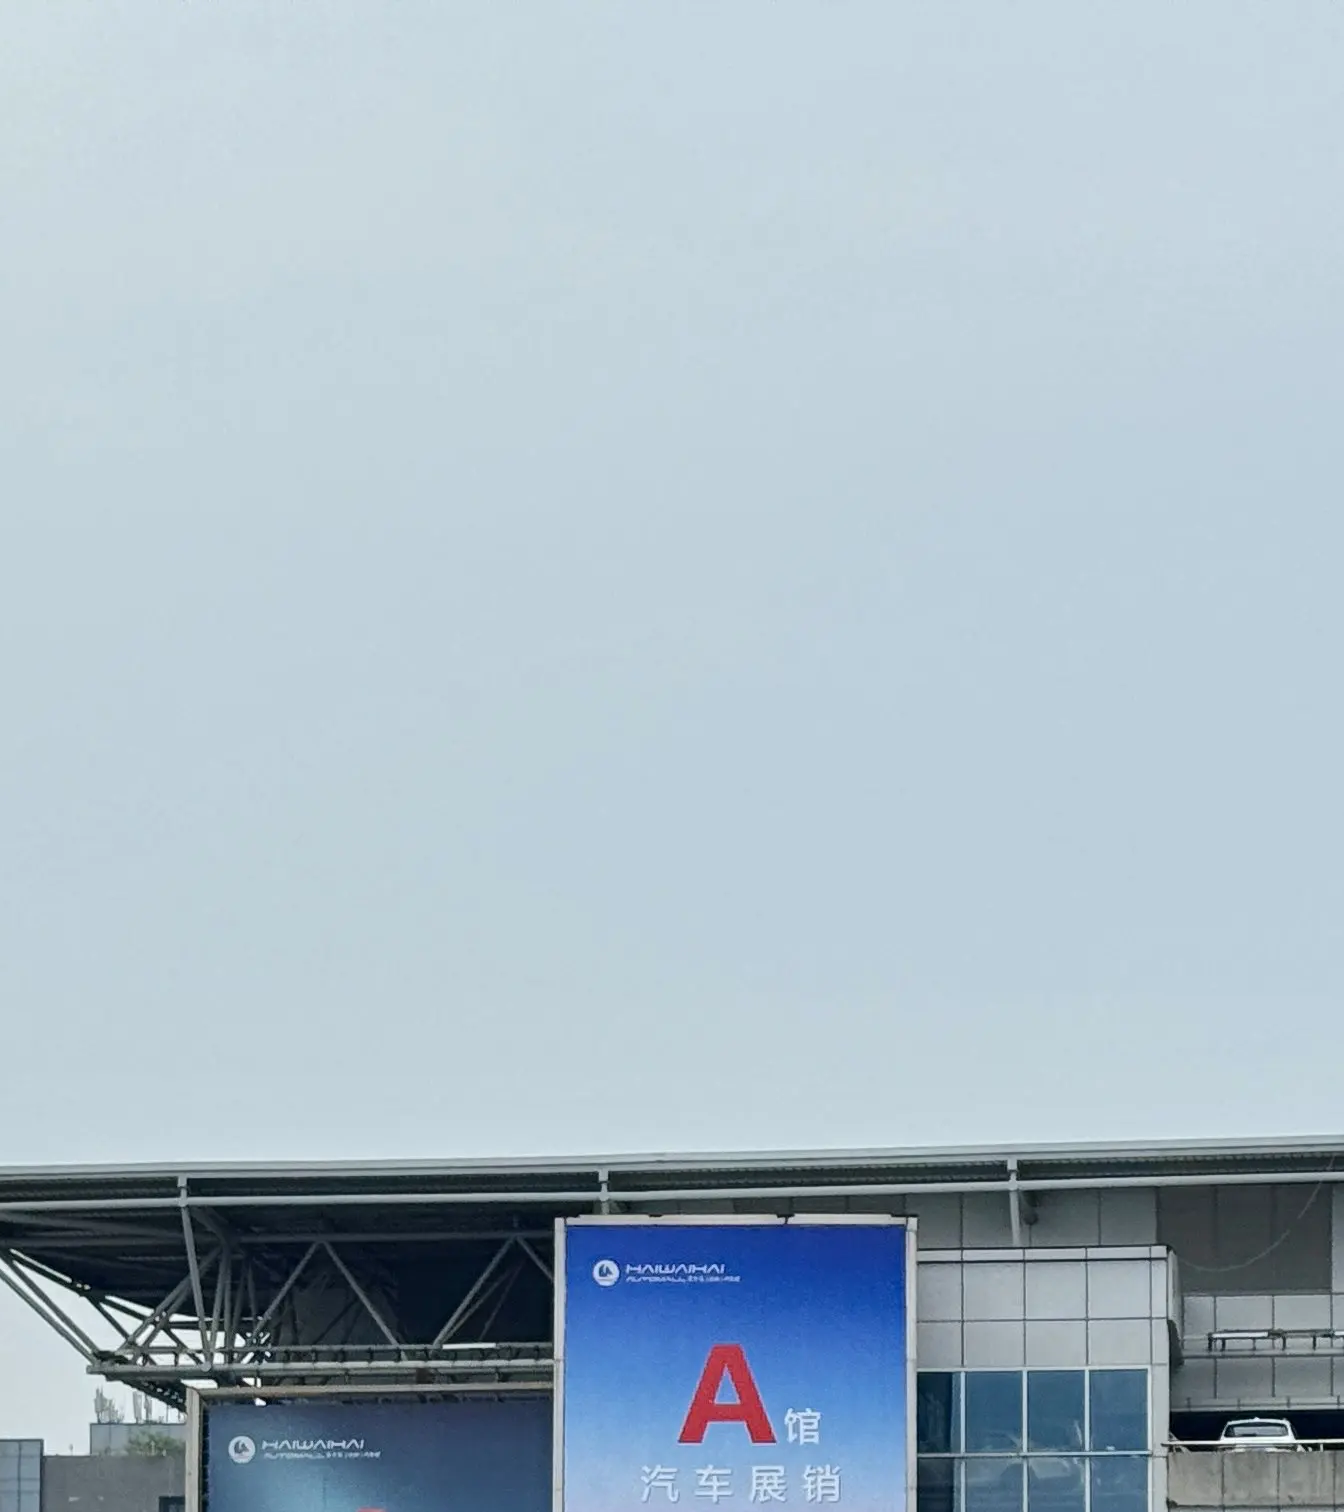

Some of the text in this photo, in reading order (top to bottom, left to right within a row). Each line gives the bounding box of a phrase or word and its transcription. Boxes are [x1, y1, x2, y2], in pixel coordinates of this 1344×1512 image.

[625, 1263, 725, 1274] HAIWAIHAI
[261, 1438, 365, 1450] HAIWAIHAI
[639, 1464, 843, 1503] 汽车展销
